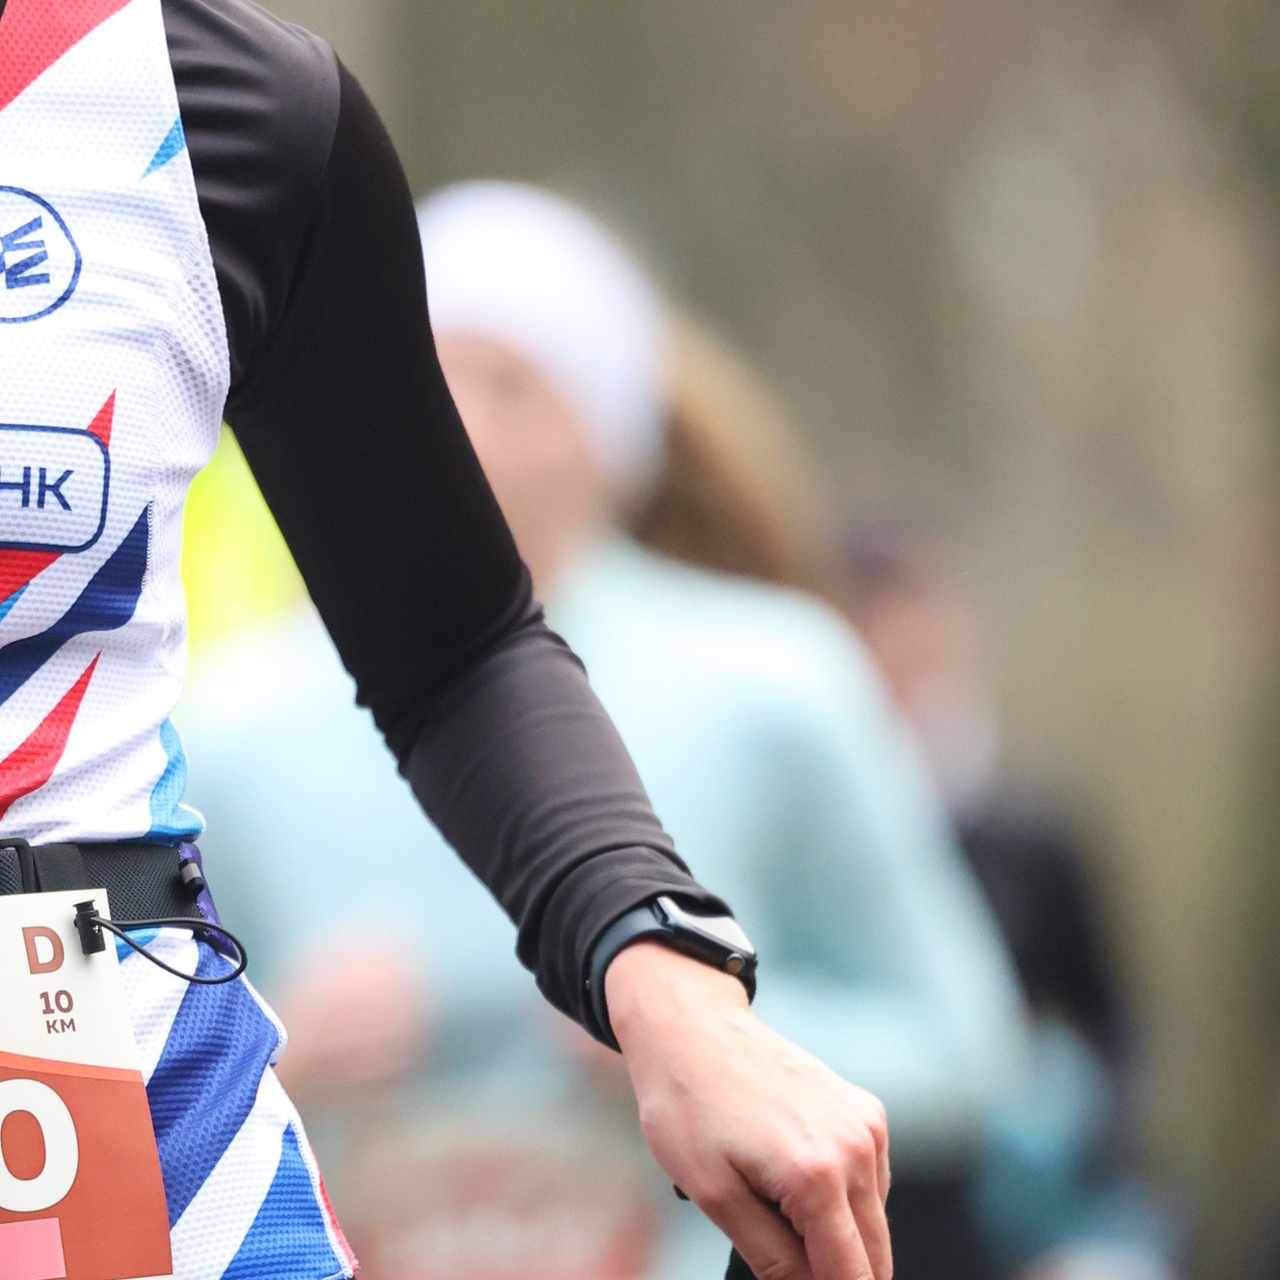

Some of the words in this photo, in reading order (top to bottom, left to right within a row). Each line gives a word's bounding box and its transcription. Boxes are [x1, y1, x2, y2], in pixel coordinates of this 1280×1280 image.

[22, 926, 65, 975] D
[40, 990, 74, 1014] 10
[46, 1018, 76, 1034] КМ
